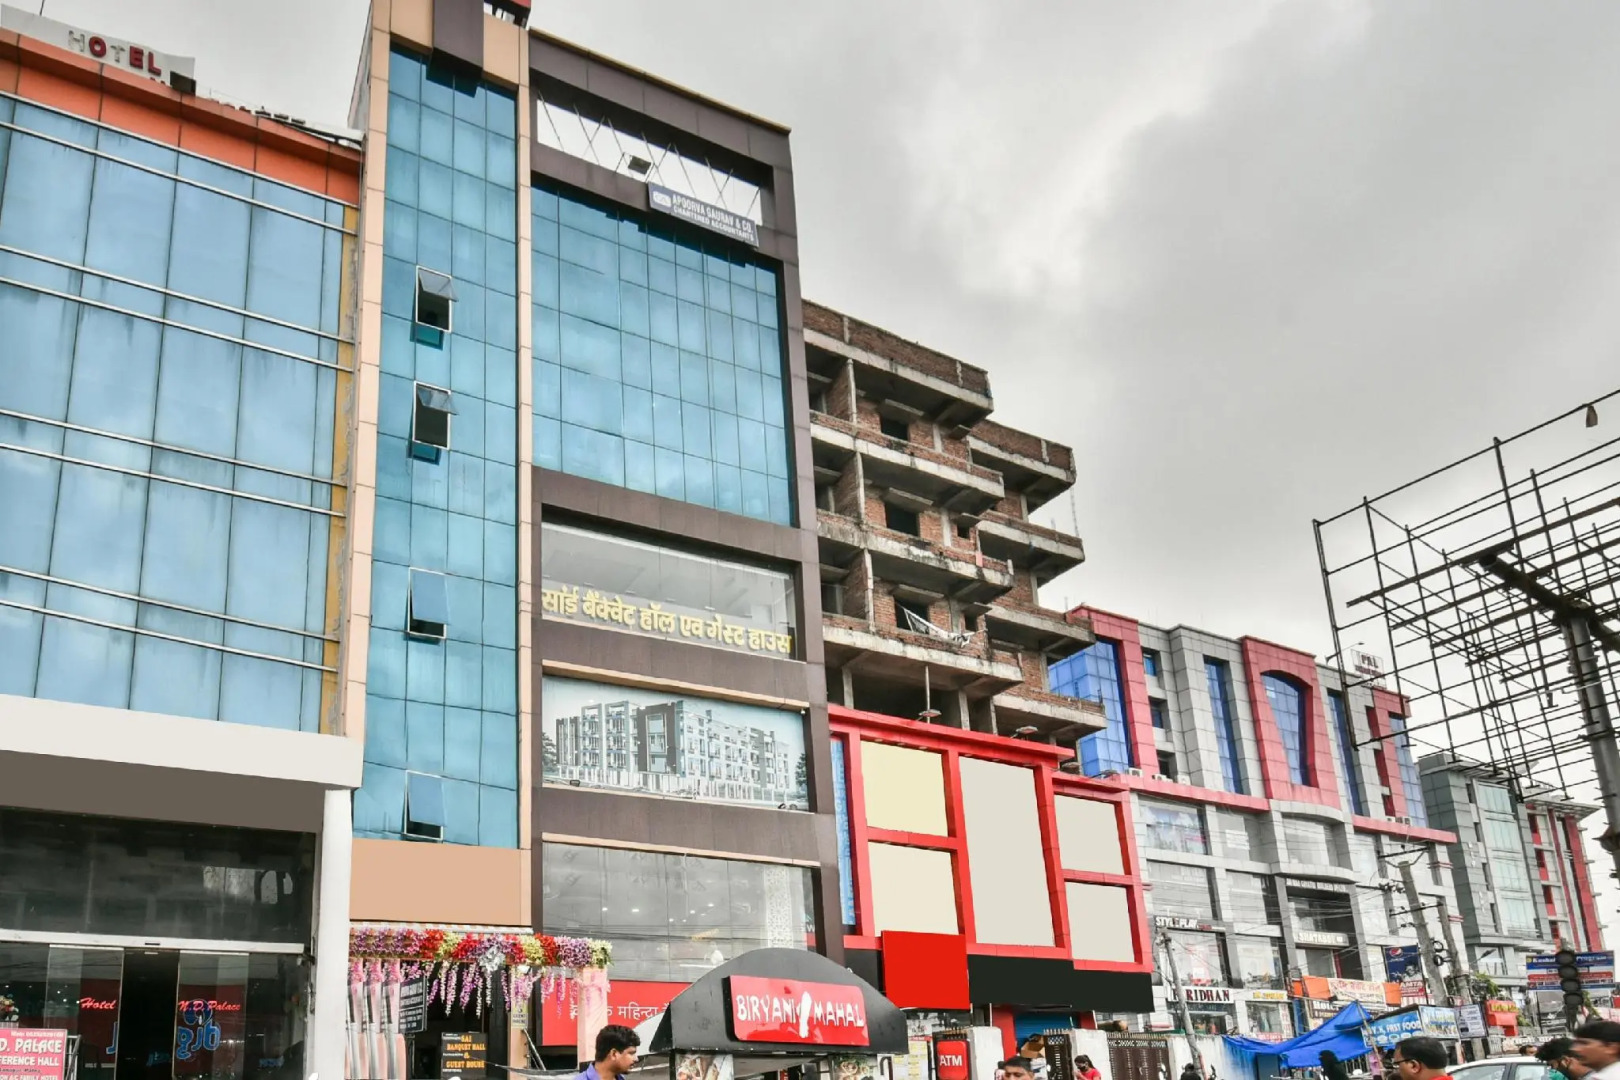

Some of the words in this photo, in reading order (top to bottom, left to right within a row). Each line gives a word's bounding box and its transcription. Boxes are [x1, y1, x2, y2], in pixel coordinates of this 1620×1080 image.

[68, 30, 162, 77] HOTEL
[672, 194, 705, 215] APOORVA
[706, 207, 734, 226] GAURAV
[736, 218, 741, 229] &
[742, 220, 754, 234] CO.
[673, 205, 711, 226] CHARTERED
[711, 220, 755, 241] ACCOUNTANTS
[748, 628, 792, 653] हाउस
[1172, 987, 1230, 1002] PRIDHAN
[79, 997, 117, 1010] Hotel
[206, 1000, 241, 1012] Palace
[736, 994, 796, 1023] BIRYANI
[814, 1002, 865, 1028] MAHAL
[15, 1037, 63, 1054] PALACE
[446, 1043, 471, 1051] BANQUET
[472, 1043, 486, 1051] HALL
[37, 1056, 60, 1067] HALL
[446, 1060, 465, 1068] GUEST
[466, 1060, 485, 1068] HOUSE
[940, 1054, 963, 1067] ATM
